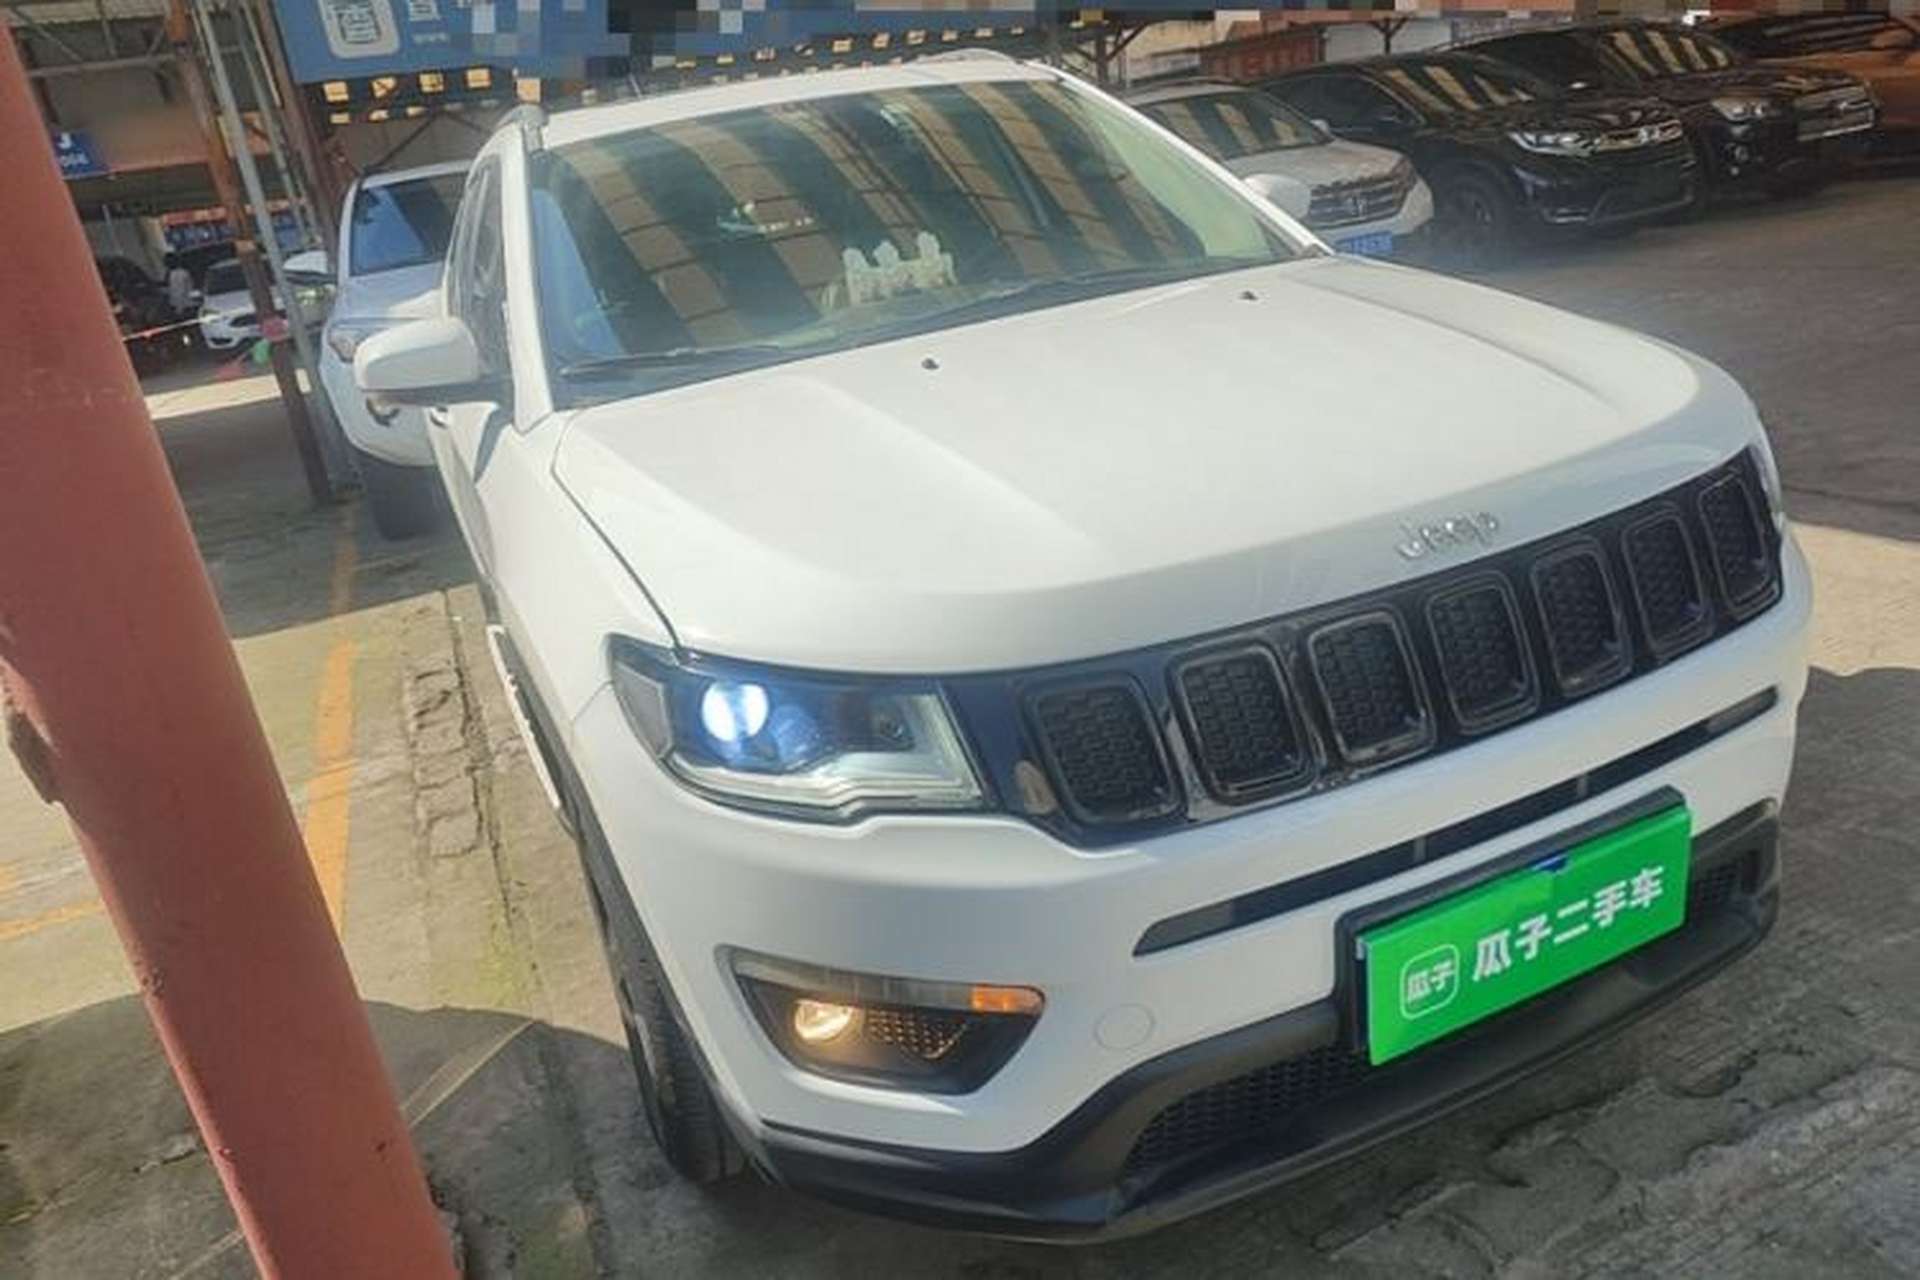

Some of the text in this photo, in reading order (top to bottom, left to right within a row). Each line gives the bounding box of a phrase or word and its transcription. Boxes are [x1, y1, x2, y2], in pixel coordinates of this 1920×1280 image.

[1396, 511, 1498, 559] Jeep
[1473, 866, 1663, 981] 瓜子二手车
[1406, 960, 1453, 1002] 瓜子
